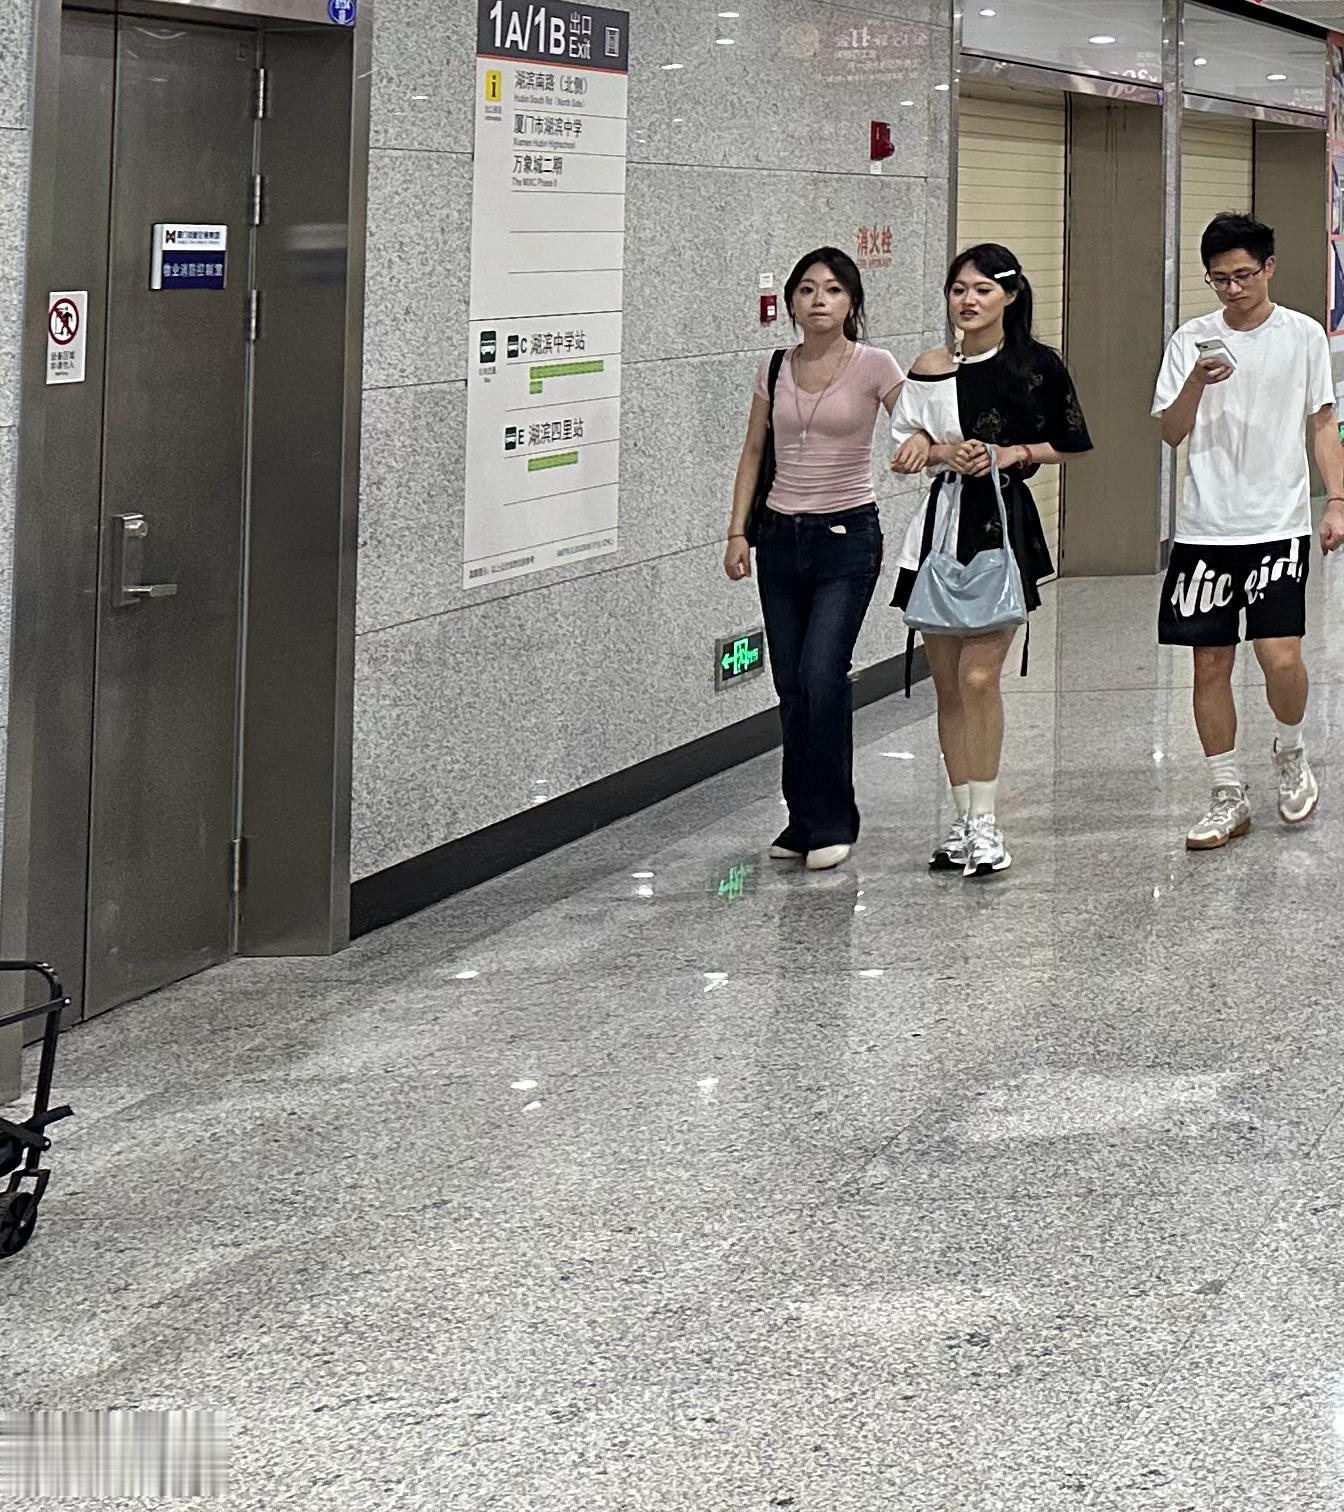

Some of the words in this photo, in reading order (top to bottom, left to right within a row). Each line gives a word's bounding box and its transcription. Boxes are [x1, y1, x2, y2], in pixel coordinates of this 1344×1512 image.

[489, 0, 567, 56] 1A/1B
[569, 11, 592, 36] 出口
[568, 36, 592, 60] Exit
[520, 337, 528, 354] C
[518, 428, 525, 445] E
